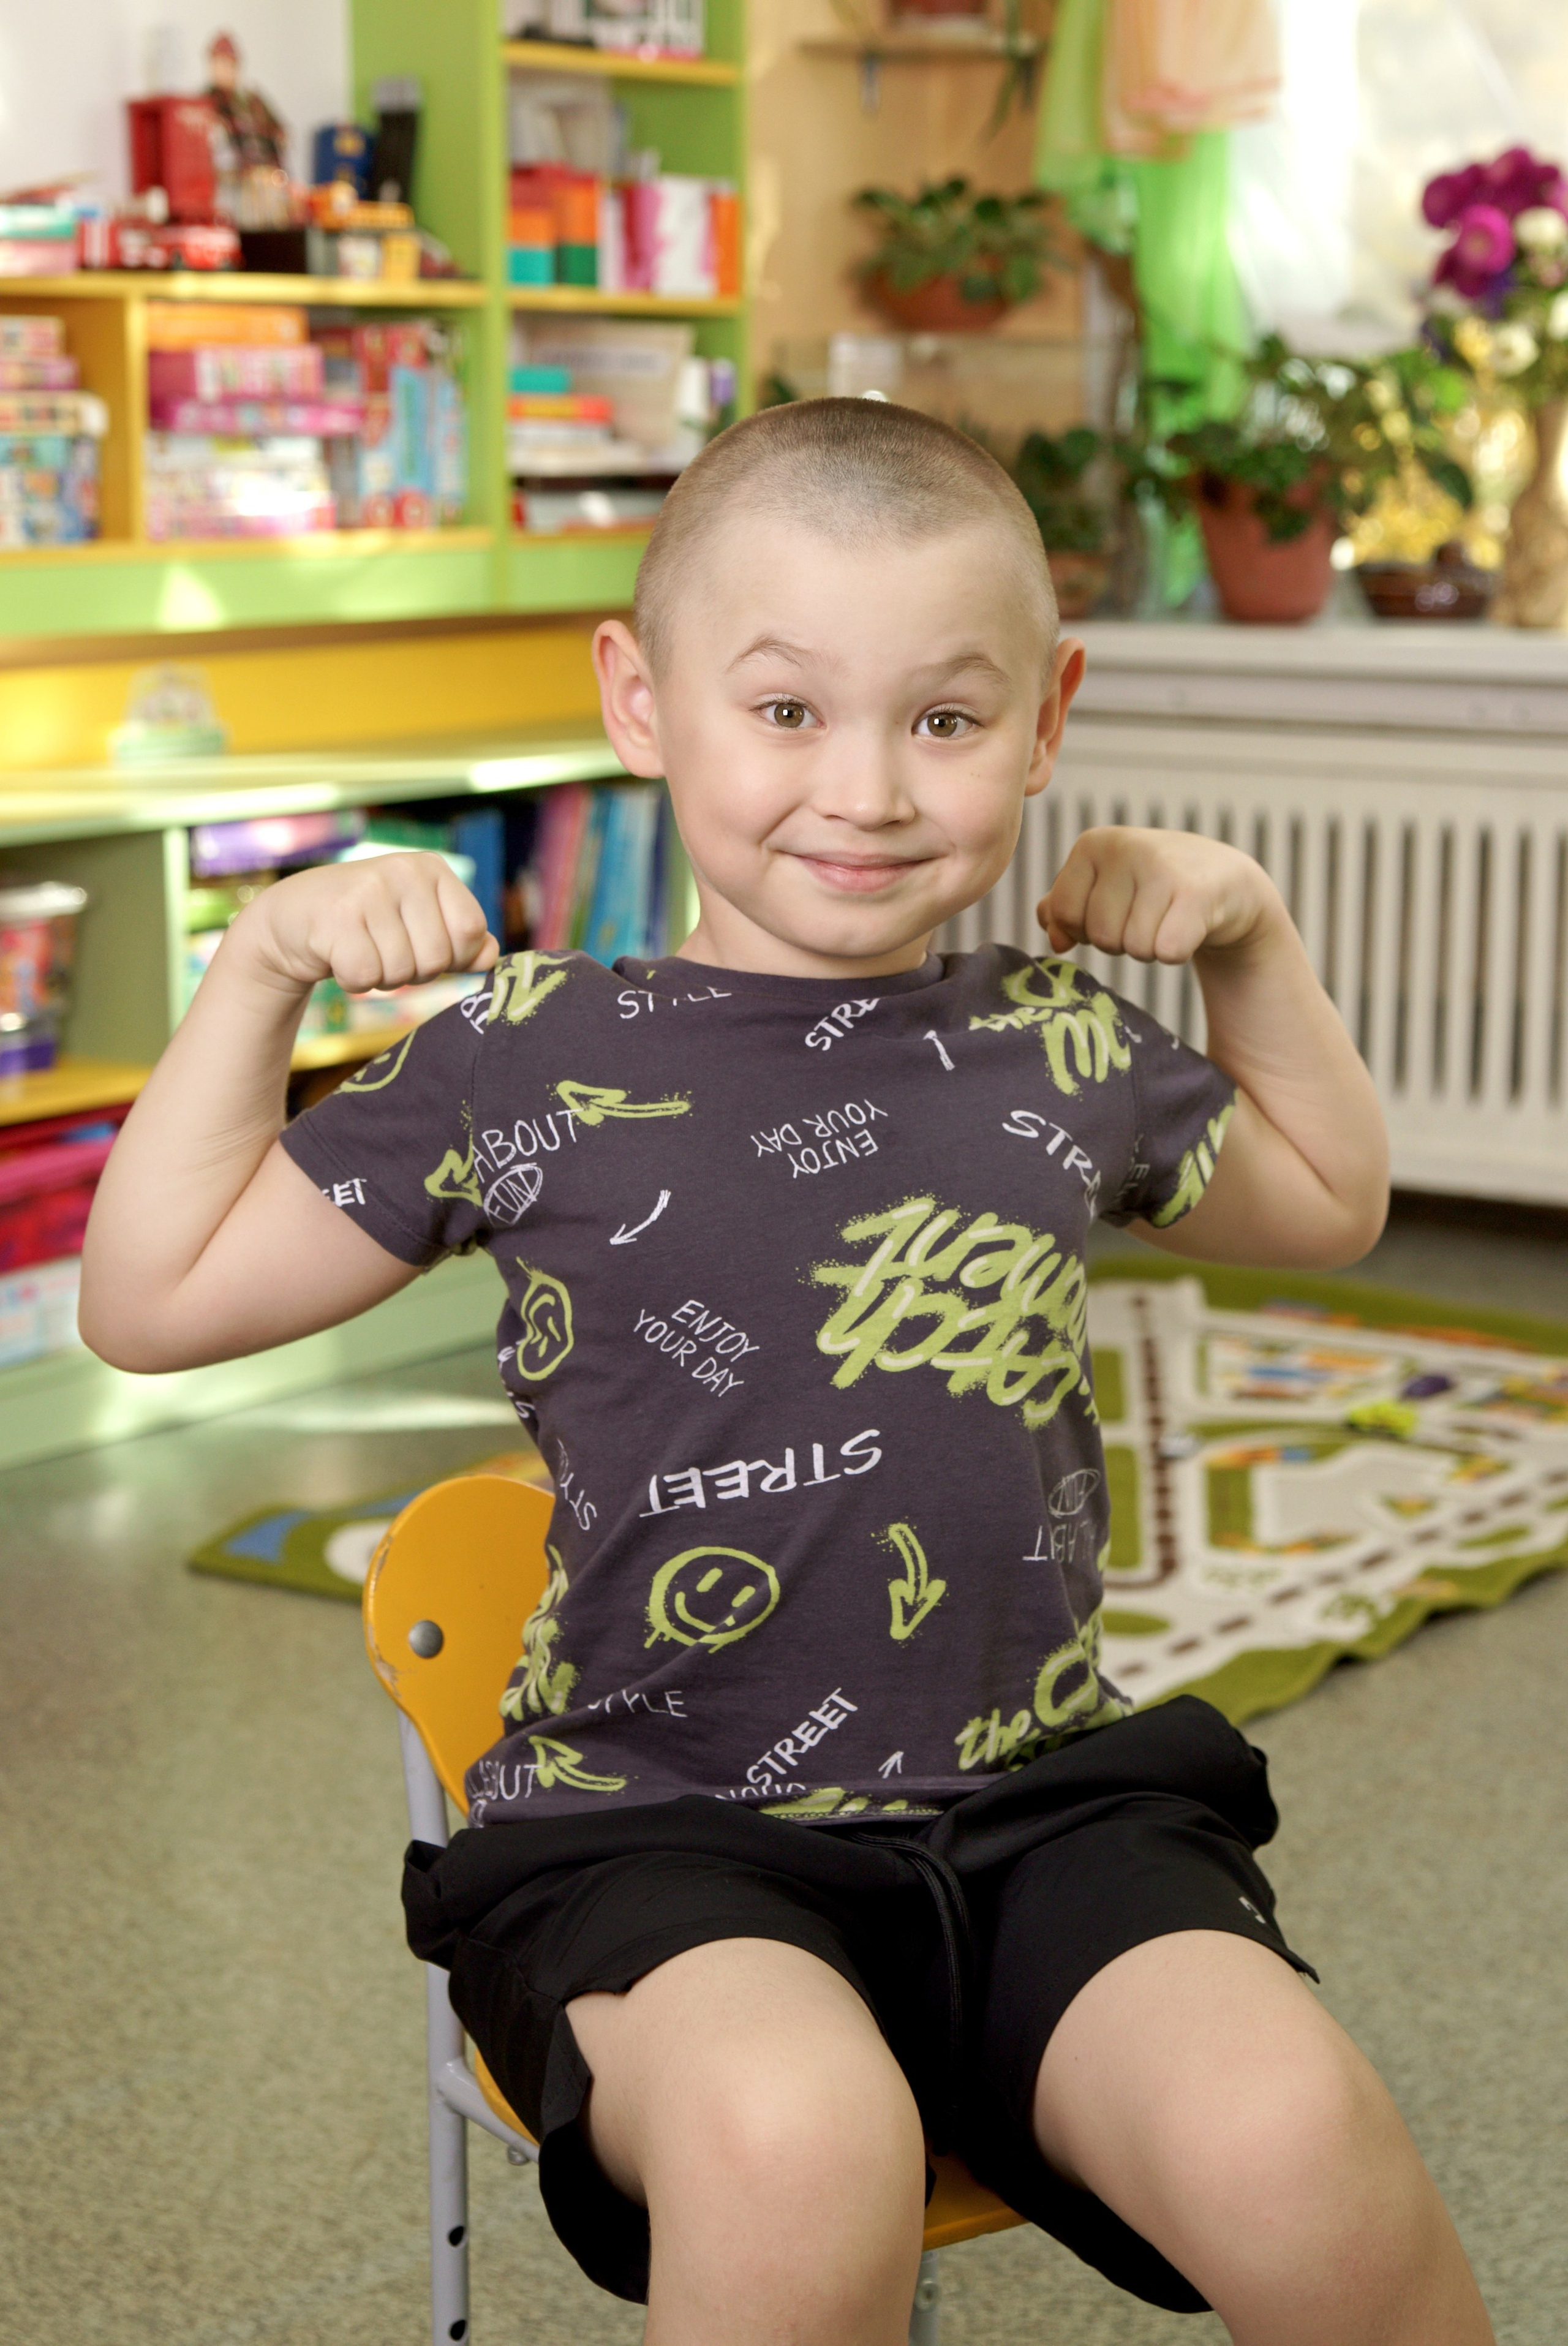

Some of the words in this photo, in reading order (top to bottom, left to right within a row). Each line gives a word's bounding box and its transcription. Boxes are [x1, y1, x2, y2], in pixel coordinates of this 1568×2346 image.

[472, 1108, 583, 1183] ABOUT
[750, 1123, 802, 1158] DAY
[802, 1099, 889, 1137] YOUR
[786, 1129, 879, 1179] ENJOY
[633, 1308, 697, 1367] YOUR
[692, 1357, 744, 1397] DAY
[671, 1300, 760, 1362] ENJOY
[639, 1429, 882, 1518] STREET
[746, 1688, 858, 1787] STREET
